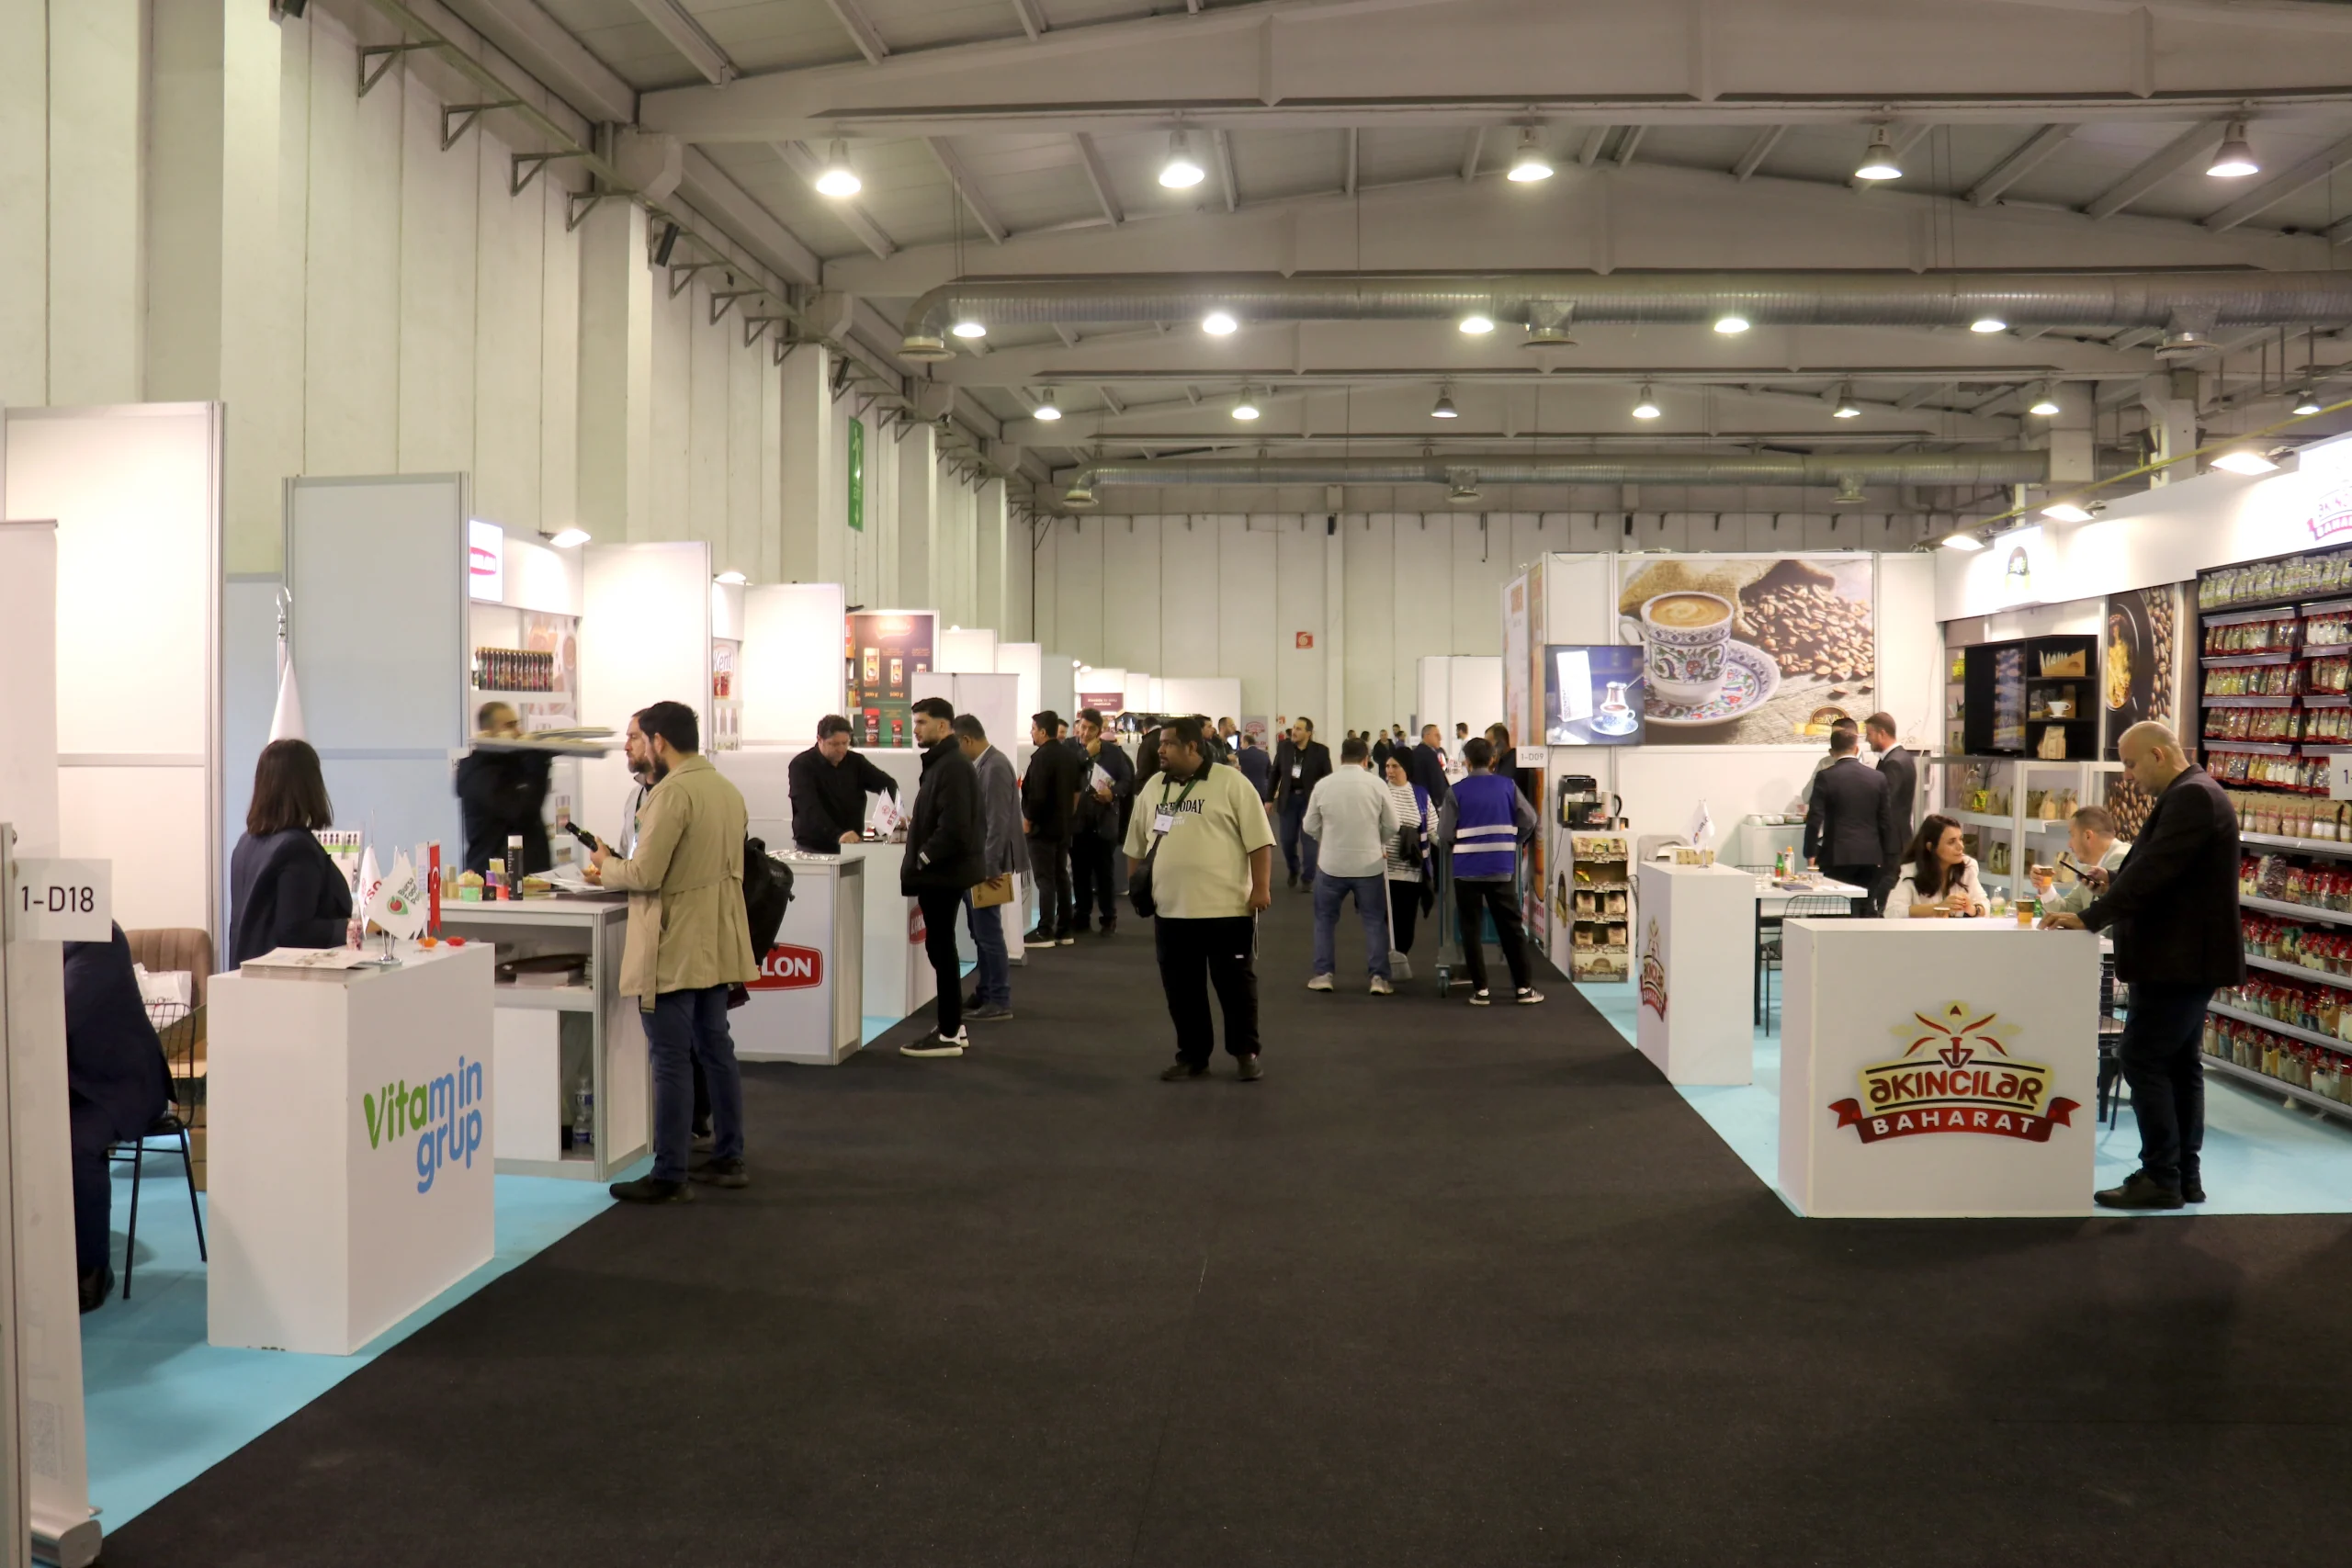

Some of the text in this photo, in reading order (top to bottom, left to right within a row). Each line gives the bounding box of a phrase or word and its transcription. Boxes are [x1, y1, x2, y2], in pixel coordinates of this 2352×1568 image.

[1521, 753, 1544, 761] 1-D09
[21, 886, 95, 912] 1-D18
[397, 877, 414, 897] Bursa
[758, 956, 812, 977] LON
[364, 1055, 482, 1150] Vitamin
[1872, 1111, 2035, 1135] BAHARAT
[417, 1109, 482, 1194] grup
